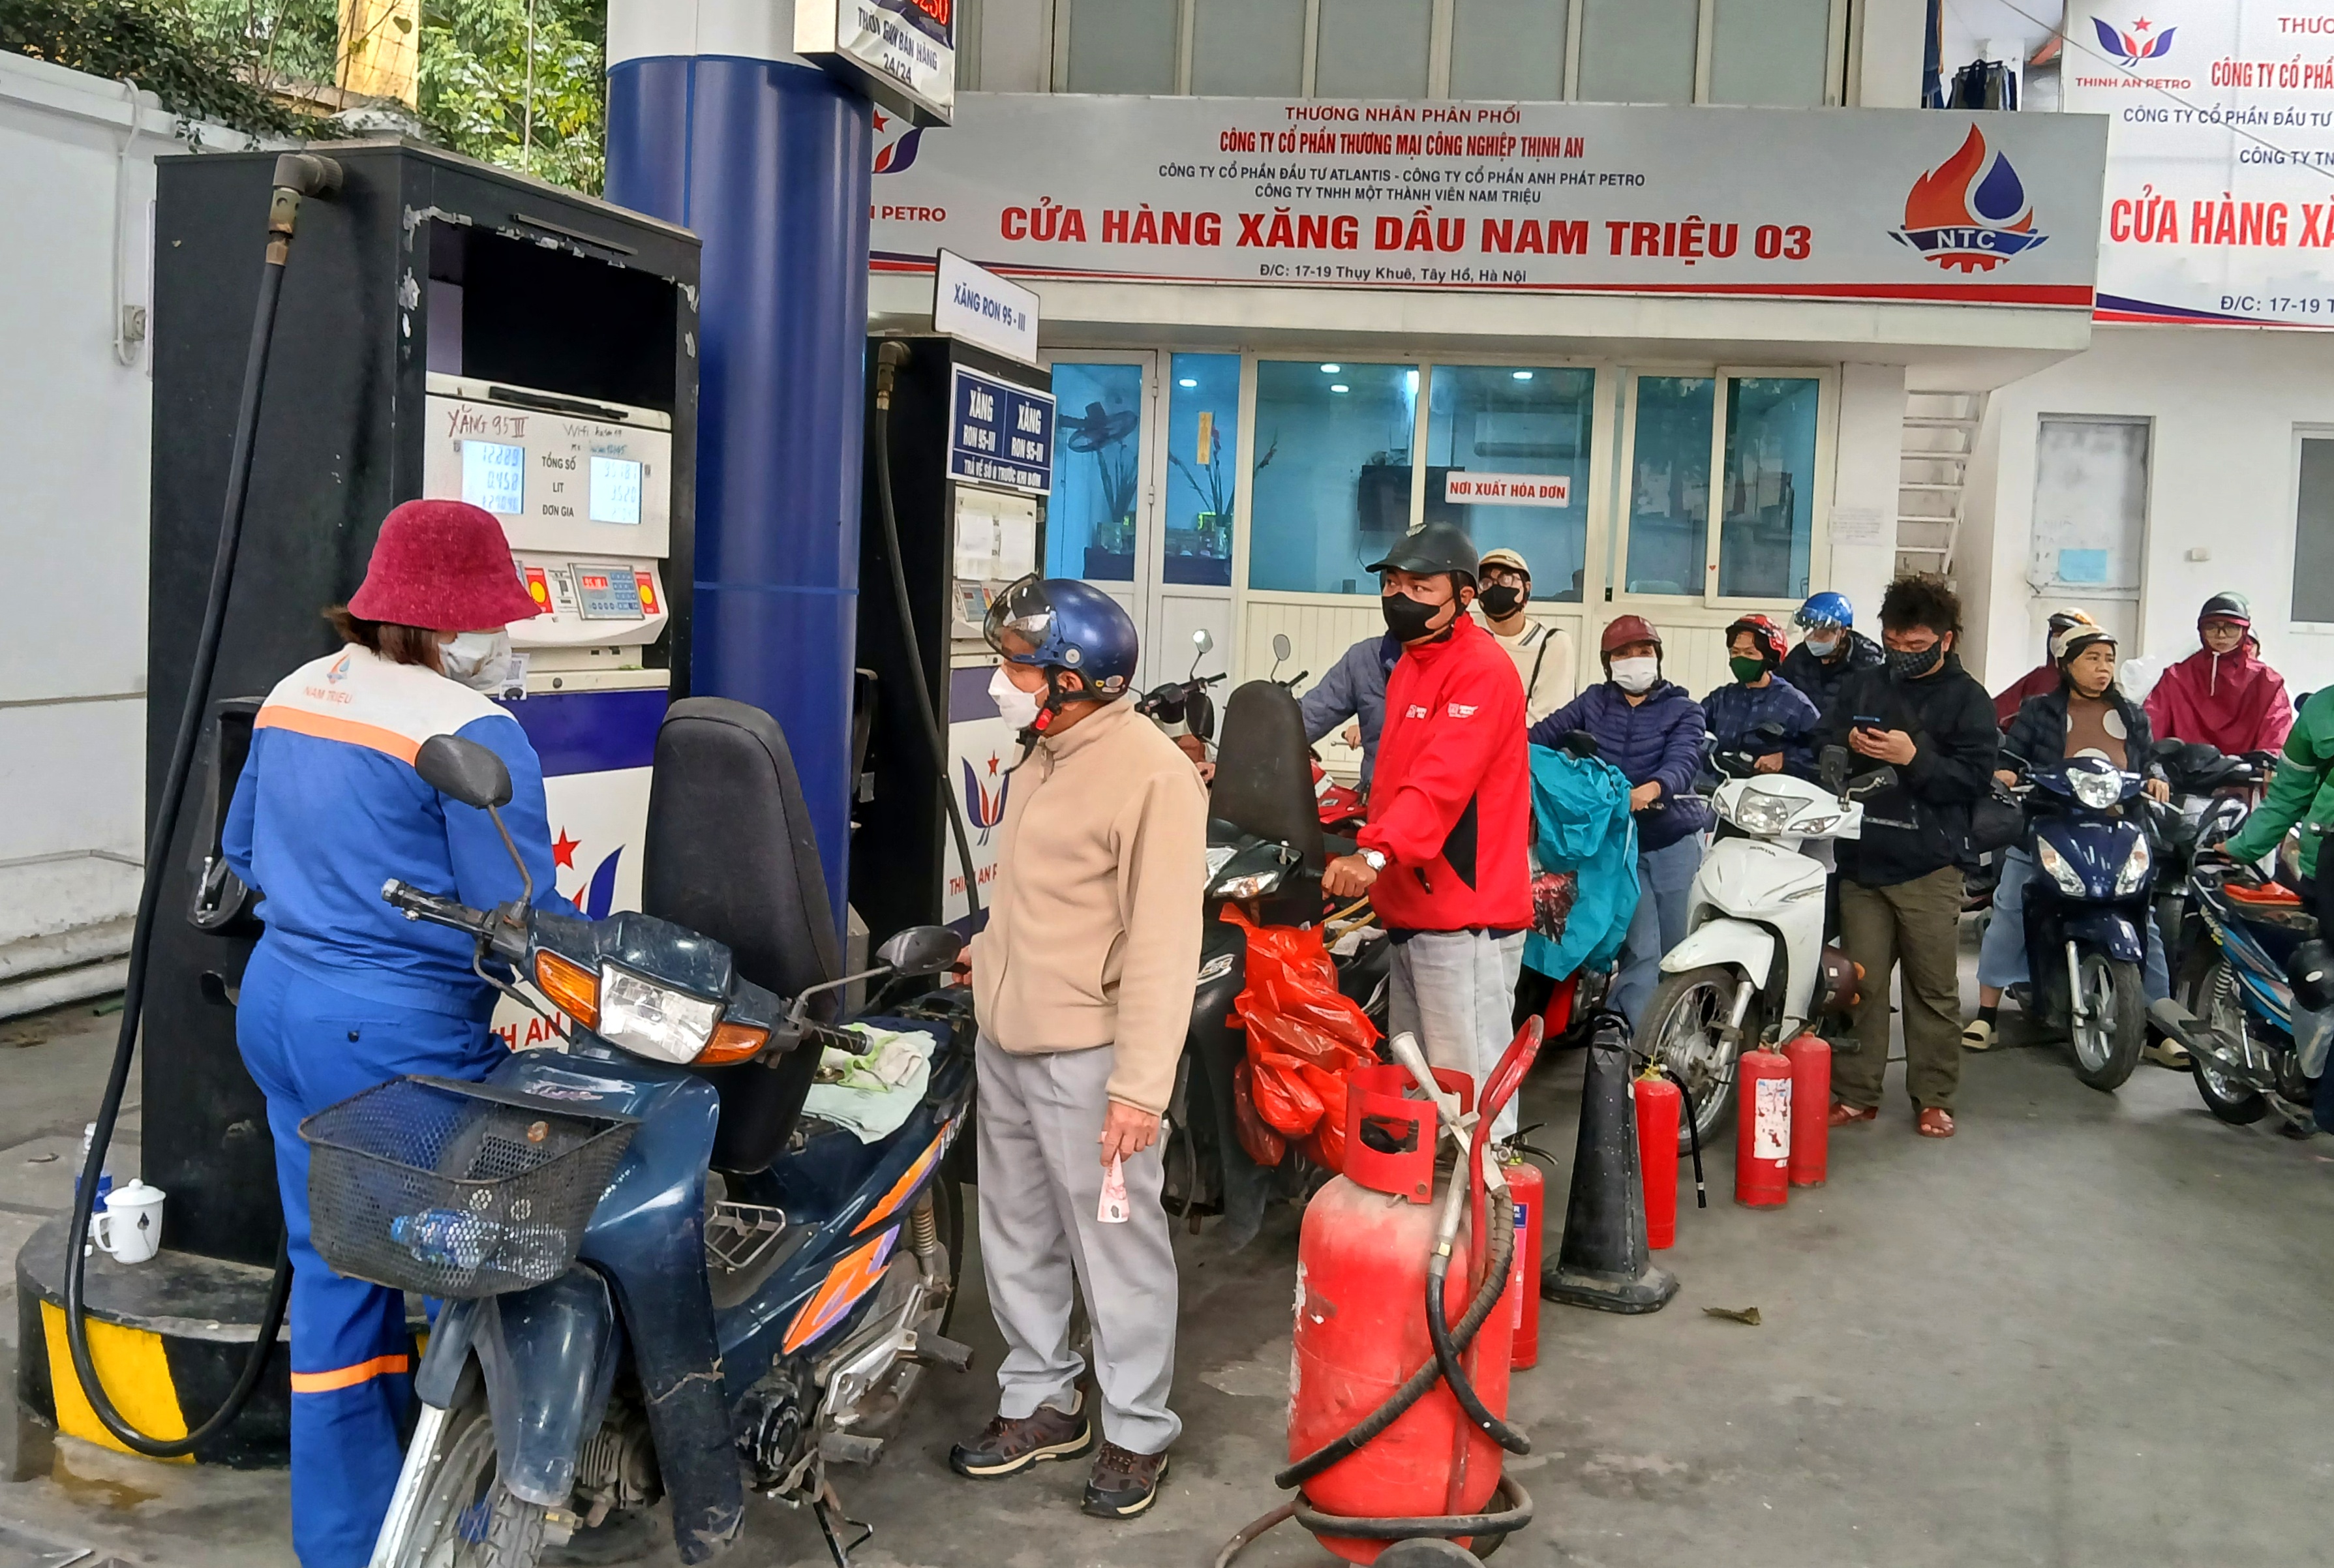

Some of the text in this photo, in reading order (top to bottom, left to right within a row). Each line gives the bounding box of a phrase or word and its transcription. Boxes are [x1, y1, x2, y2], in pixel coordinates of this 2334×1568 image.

[898, 31, 915, 58] BÁN
[916, 42, 937, 71] HÀNG
[883, 52, 912, 84] 24/24
[2211, 56, 2253, 87] CÔNG
[2257, 63, 2275, 88] TY
[2279, 53, 2301, 89] CỔ
[2121, 78, 2142, 89] AN
[2145, 78, 2191, 90] PETRO
[1285, 104, 1521, 124] THƯƠNG NHÂN PHÂN PHỐI
[2123, 104, 2168, 123] CÔNG
[2173, 109, 2193, 124] TY
[2198, 102, 2222, 124] CỔ
[2310, 111, 2333, 127] TƯ
[1220, 127, 1256, 152] CÔNG
[1260, 132, 1275, 153] TY
[1279, 124, 1297, 153] CỔ
[1341, 131, 1391, 155] THƯƠNG
[1396, 134, 1421, 160] MẠI
[1426, 131, 1463, 157] CÔNG
[1466, 132, 1516, 162] NGHIỆP
[1521, 136, 1560, 162] THỊNH
[1564, 137, 1584, 158] AN
[2239, 145, 2285, 164] CÔNG
[2290, 151, 2311, 164] TY
[1159, 162, 1195, 177] CÔNG
[1199, 166, 1215, 178] TY
[1219, 160, 1237, 179] CỔ
[1310, 167, 1328, 181] TƯ
[1329, 168, 1391, 181] ATLANTIS
[1402, 167, 1440, 183] CÔNG
[1444, 170, 1461, 183] TY
[1464, 165, 1485, 183] CỔ
[1527, 172, 1556, 185] ANH
[1560, 170, 1596, 185] PHÁT
[1599, 173, 1645, 187] PETRO
[1255, 183, 1541, 205] CÔNG TY TNHH MỘT THÀNH VIÊN NAM TRIỆU
[881, 205, 947, 222] PETRO
[2110, 183, 2179, 243] CỬA
[2190, 190, 2288, 247] HÀNG
[1000, 196, 1812, 266] CỬA HÀNG XĂNG DẦU NAM TRIỆU 03
[1935, 228, 1997, 250] NTC
[1260, 264, 1290, 277] Đ/C:
[1294, 264, 1331, 278] 17-19
[1335, 265, 1371, 281] Thụy
[1375, 267, 1416, 282] Khuê,
[1421, 268, 1446, 283] Tây
[1479, 269, 1498, 282] Hà
[1502, 269, 1526, 284] Nội
[953, 282, 980, 312] XĂNG
[982, 296, 1001, 322] RON
[1002, 305, 1012, 326] 95
[1018, 312, 1026, 332] III
[2220, 295, 2262, 312] Đ/C:
[2269, 297, 2320, 314] 17-19
[969, 386, 994, 423] XĂNG
[1017, 400, 1042, 435] XĂNG
[963, 424, 978, 448] RON
[1011, 436, 1026, 459] RON
[541, 451, 577, 470] TỔNG SỐ
[1016, 470, 1027, 485] KHI
[1449, 479, 1566, 500] NƠI XUẤT HÓA ĐƠN
[542, 504, 560, 517] ĐƠN
